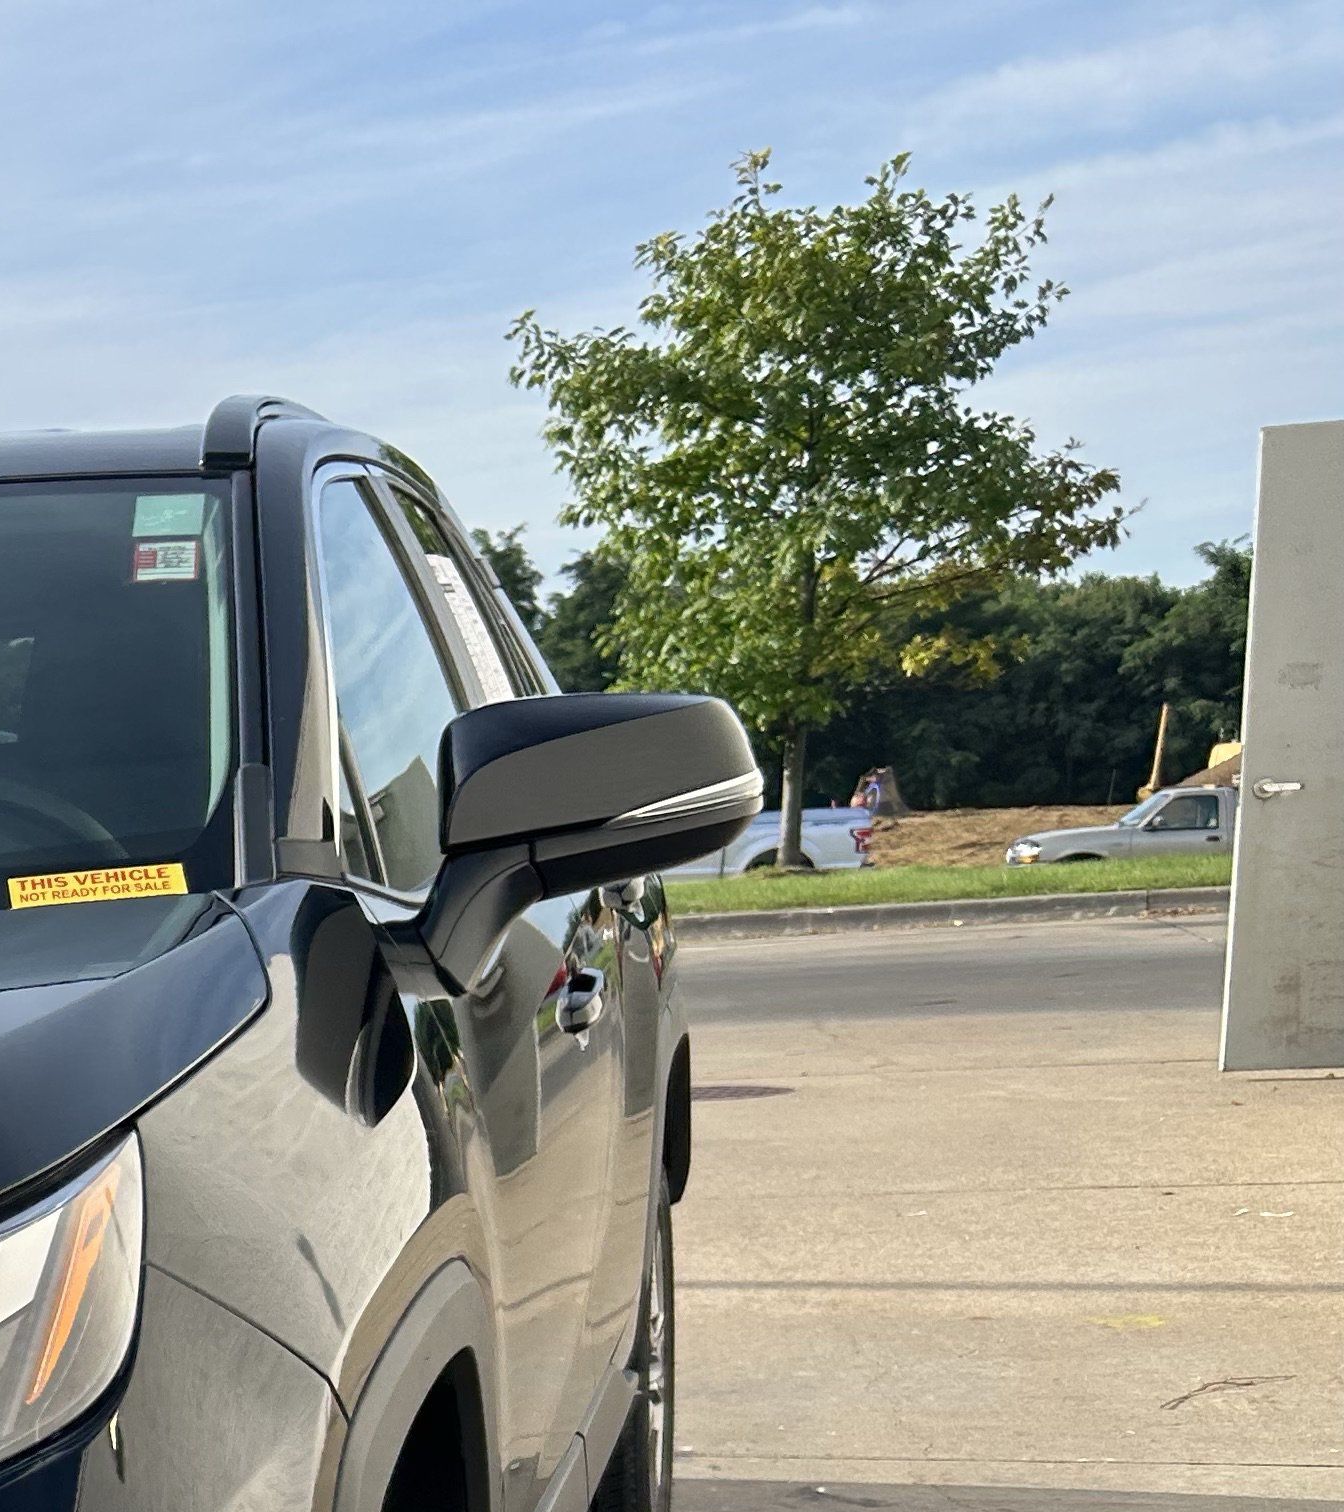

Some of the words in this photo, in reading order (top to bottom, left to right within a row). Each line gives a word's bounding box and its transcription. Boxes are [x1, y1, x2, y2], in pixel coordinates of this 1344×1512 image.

[16, 875, 68, 892] THIS
[73, 867, 171, 886] VEHICLE
[19, 891, 48, 904] NOT
[52, 886, 99, 901] READY
[103, 882, 131, 895] FOR
[134, 880, 172, 892] SALE
